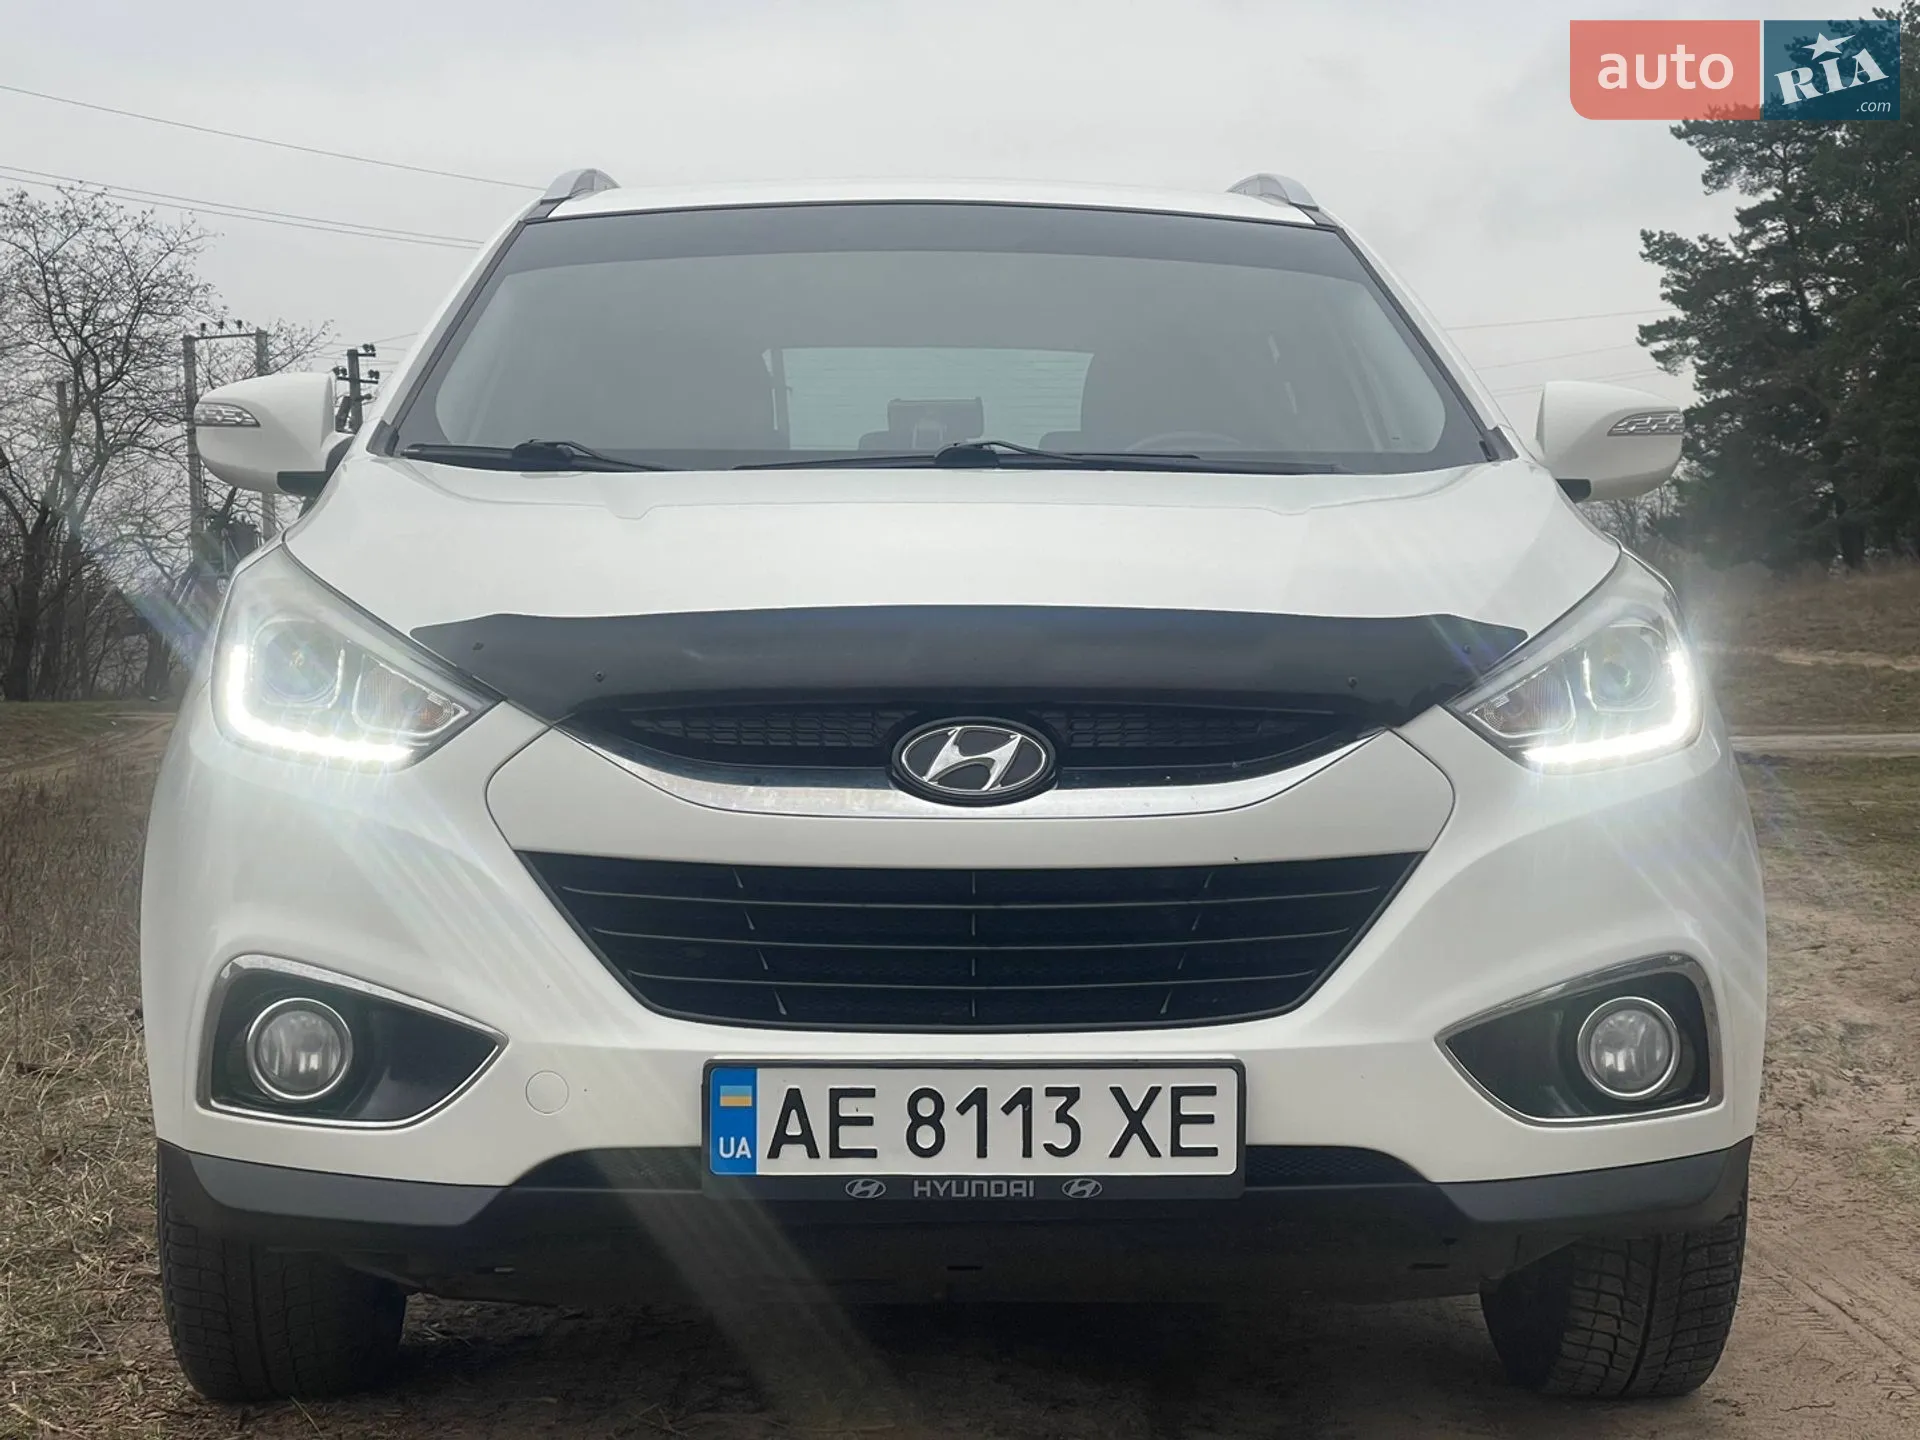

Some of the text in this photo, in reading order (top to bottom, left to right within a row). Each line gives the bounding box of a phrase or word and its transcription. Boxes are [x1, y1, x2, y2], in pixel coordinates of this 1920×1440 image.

[767, 1085, 1219, 1159] AE 8113 XE
[719, 1137, 751, 1159] UA
[913, 1180, 1035, 1198] HYUNDAI
